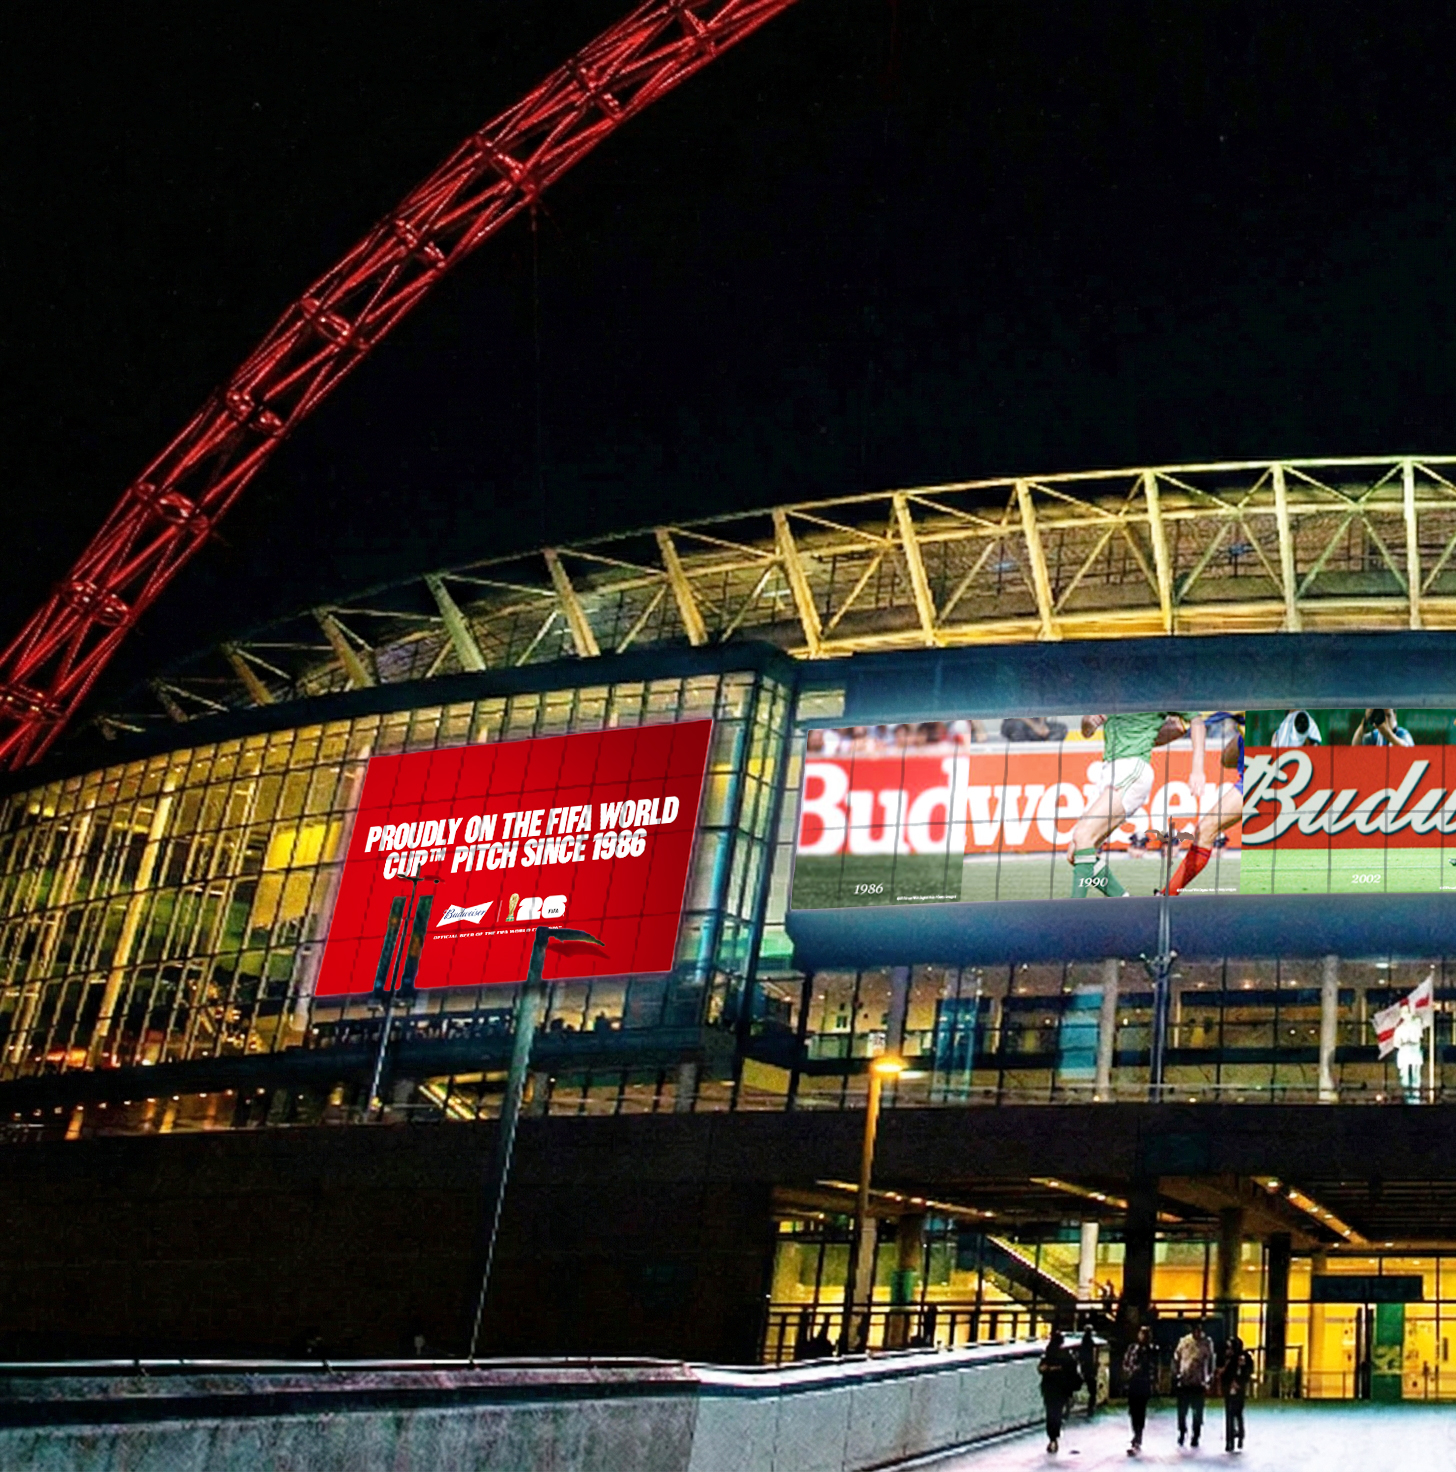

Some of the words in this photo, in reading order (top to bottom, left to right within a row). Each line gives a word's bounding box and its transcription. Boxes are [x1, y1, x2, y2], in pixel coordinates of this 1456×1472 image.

[364, 817, 464, 853] PROUDLY
[463, 813, 499, 844] ON
[501, 808, 546, 840] THE
[544, 804, 593, 836] FIFA
[599, 795, 680, 830] WORLD
[450, 840, 520, 874] PITCH
[520, 833, 590, 868] SINCE
[591, 827, 648, 861] 1986
[1077, 876, 1109, 888] 1990
[1350, 873, 1382, 885] 2002
[853, 881, 885, 896] 1986
[442, 907, 487, 921] Budweiser
